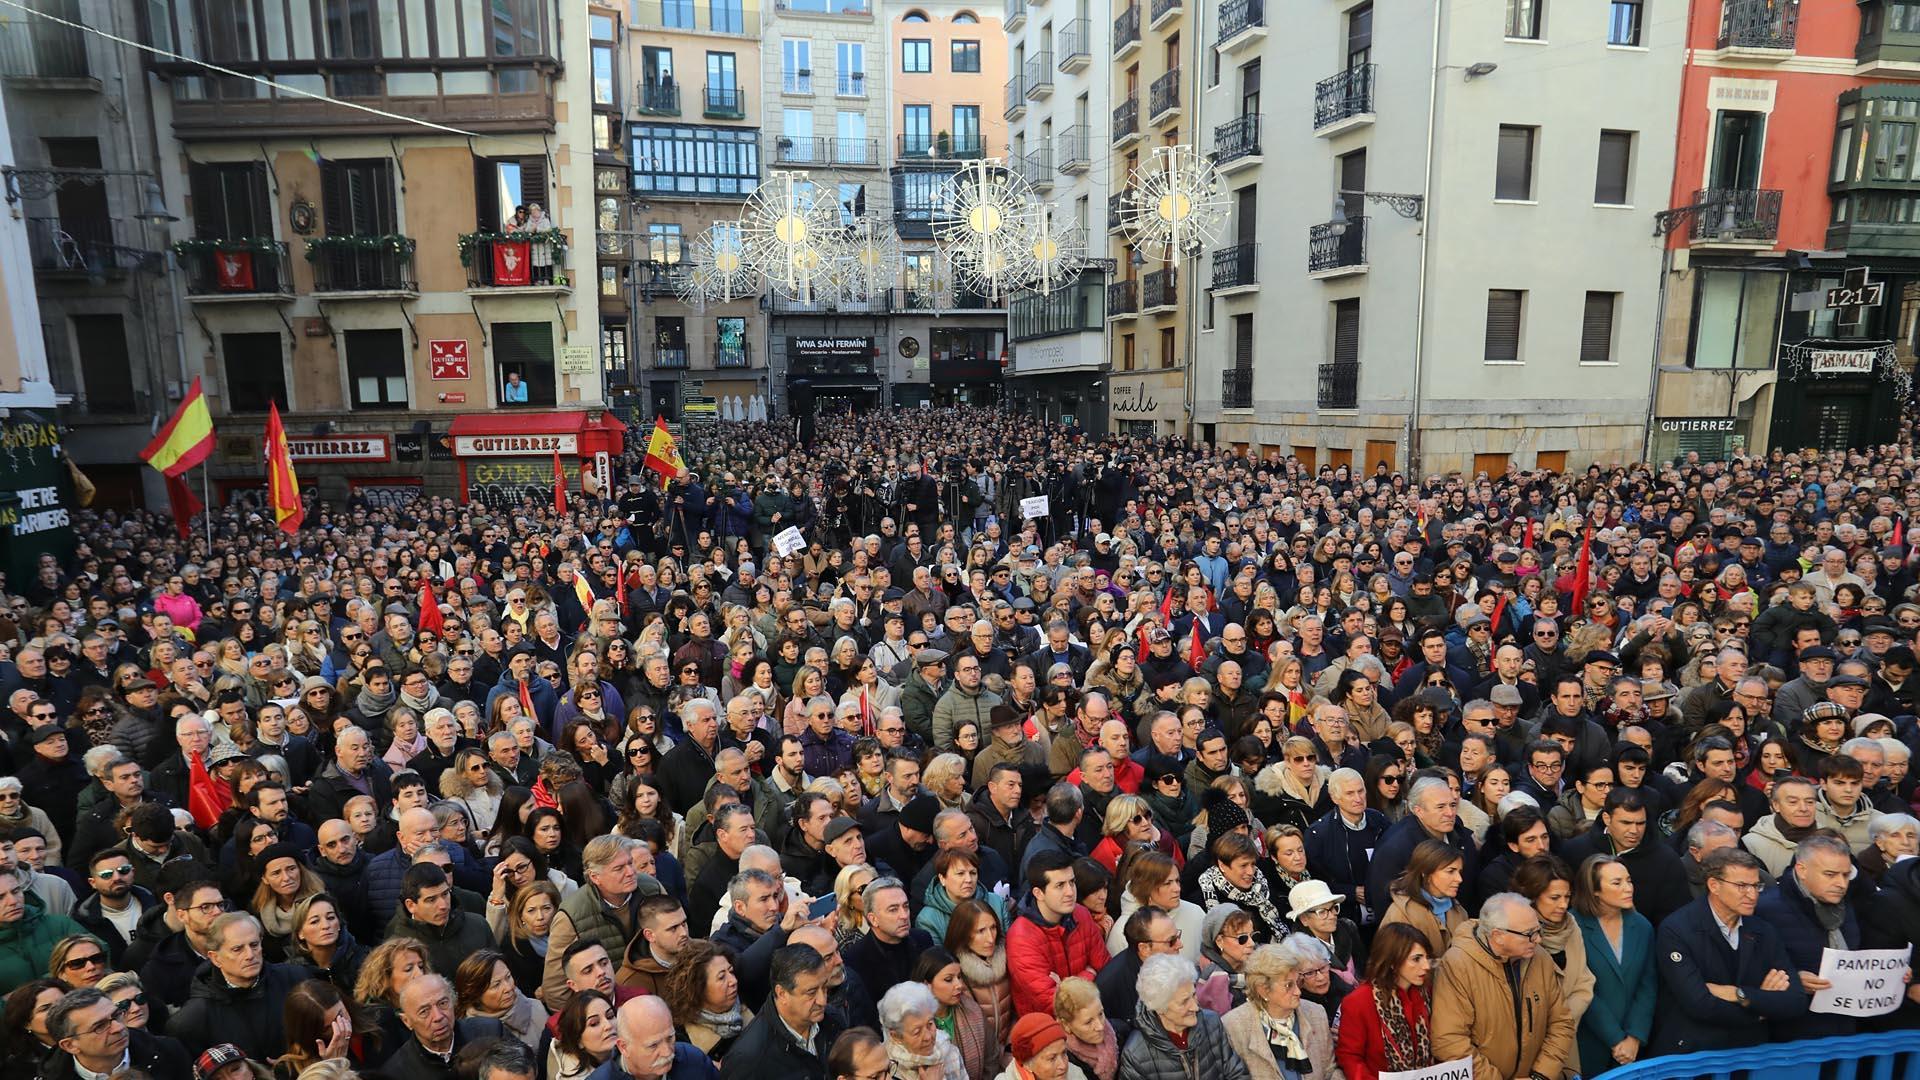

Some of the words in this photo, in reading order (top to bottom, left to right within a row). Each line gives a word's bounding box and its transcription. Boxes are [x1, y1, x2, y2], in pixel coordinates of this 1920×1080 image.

[1827, 286, 1880, 307] 12:17
[817, 340, 834, 348] SAN
[836, 338, 867, 348] FERMÍN!
[1813, 352, 1870, 370] FARMACIA
[906, 370, 913, 379] 2
[1113, 386, 1132, 395] COFFEE
[1113, 382, 1158, 412] nails
[1661, 421, 1734, 432] GUTIERREZ
[288, 442, 370, 455] GUTIERREZ
[472, 438, 561, 451] GUTIERREZ
[1864, 978, 1885, 990] NO
[1832, 997, 1853, 1009] SE
[1857, 994, 1897, 1009] VENDE
